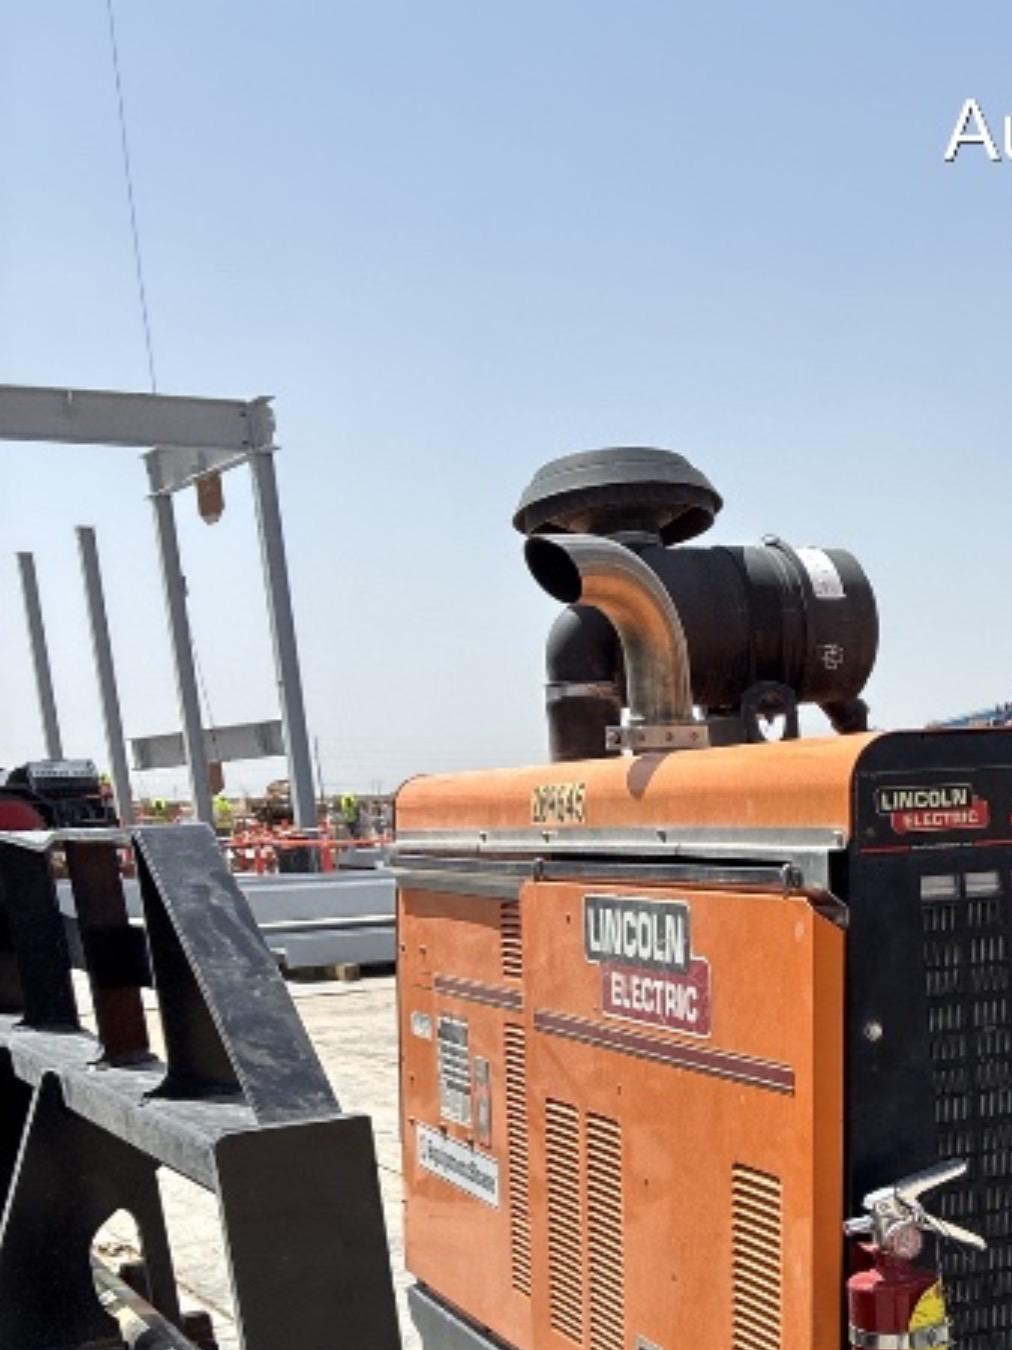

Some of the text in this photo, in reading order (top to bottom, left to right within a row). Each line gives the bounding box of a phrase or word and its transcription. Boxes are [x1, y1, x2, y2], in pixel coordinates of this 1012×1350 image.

[880, 788, 968, 810] LINCOLN
[902, 809, 979, 827] ELECTRIC
[586, 907, 686, 966] LINCOLN
[611, 971, 699, 1024] ELECTRIC
